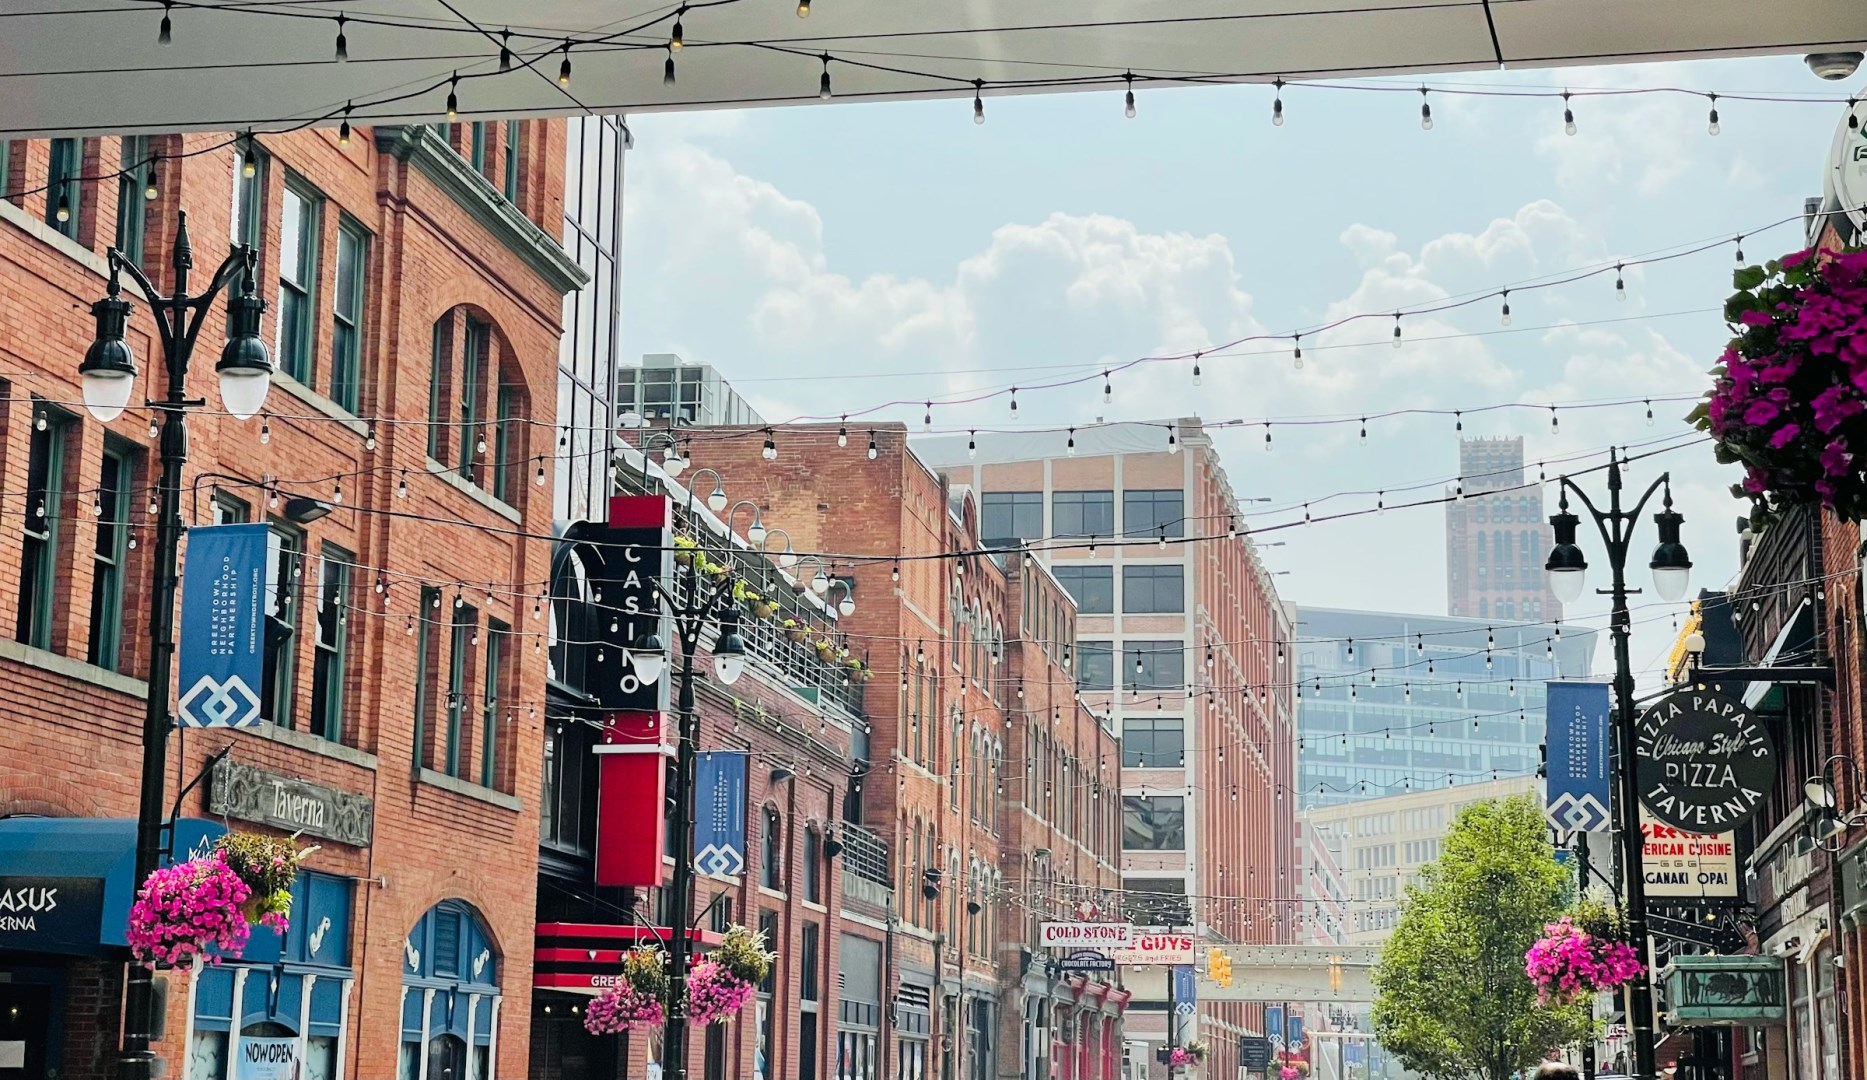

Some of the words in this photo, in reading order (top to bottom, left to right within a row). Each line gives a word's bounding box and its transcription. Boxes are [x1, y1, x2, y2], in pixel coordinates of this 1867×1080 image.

[210, 579, 220, 655] GREEKTOWN
[219, 556, 230, 655] NEIGHBORHOOD
[227, 569, 237, 655] PARTNERSHIP
[249, 567, 259, 654] GREEKTOWNDETROIT.ORG
[619, 543, 642, 694] CASINO
[1636, 702, 1683, 757] PIZZA
[1692, 696, 1769, 758] PAPALIS
[1652, 733, 1706, 762] Chicago
[1708, 731, 1747, 759] Style
[1665, 762, 1738, 788] PIZZA
[272, 779, 324, 828] Taverna
[1647, 782, 1763, 825] TAVERNA
[1643, 843, 1684, 855] ERICAN
[1697, 872, 1728, 884] OPA!
[0, 887, 58, 912] ASUS
[0, 916, 37, 931] ERNA
[1046, 926, 1081, 940] COLD
[1084, 926, 1127, 941] STONE
[1141, 936, 1192, 951] GUYS
[1061, 959, 1089, 968] CHOCOLATE
[1090, 960, 1112, 968] FACTORY
[1160, 954, 1182, 962] FRIES
[591, 975, 623, 988] GREE
[246, 1042, 268, 1063] NOW
[269, 1043, 294, 1063] OPEN
